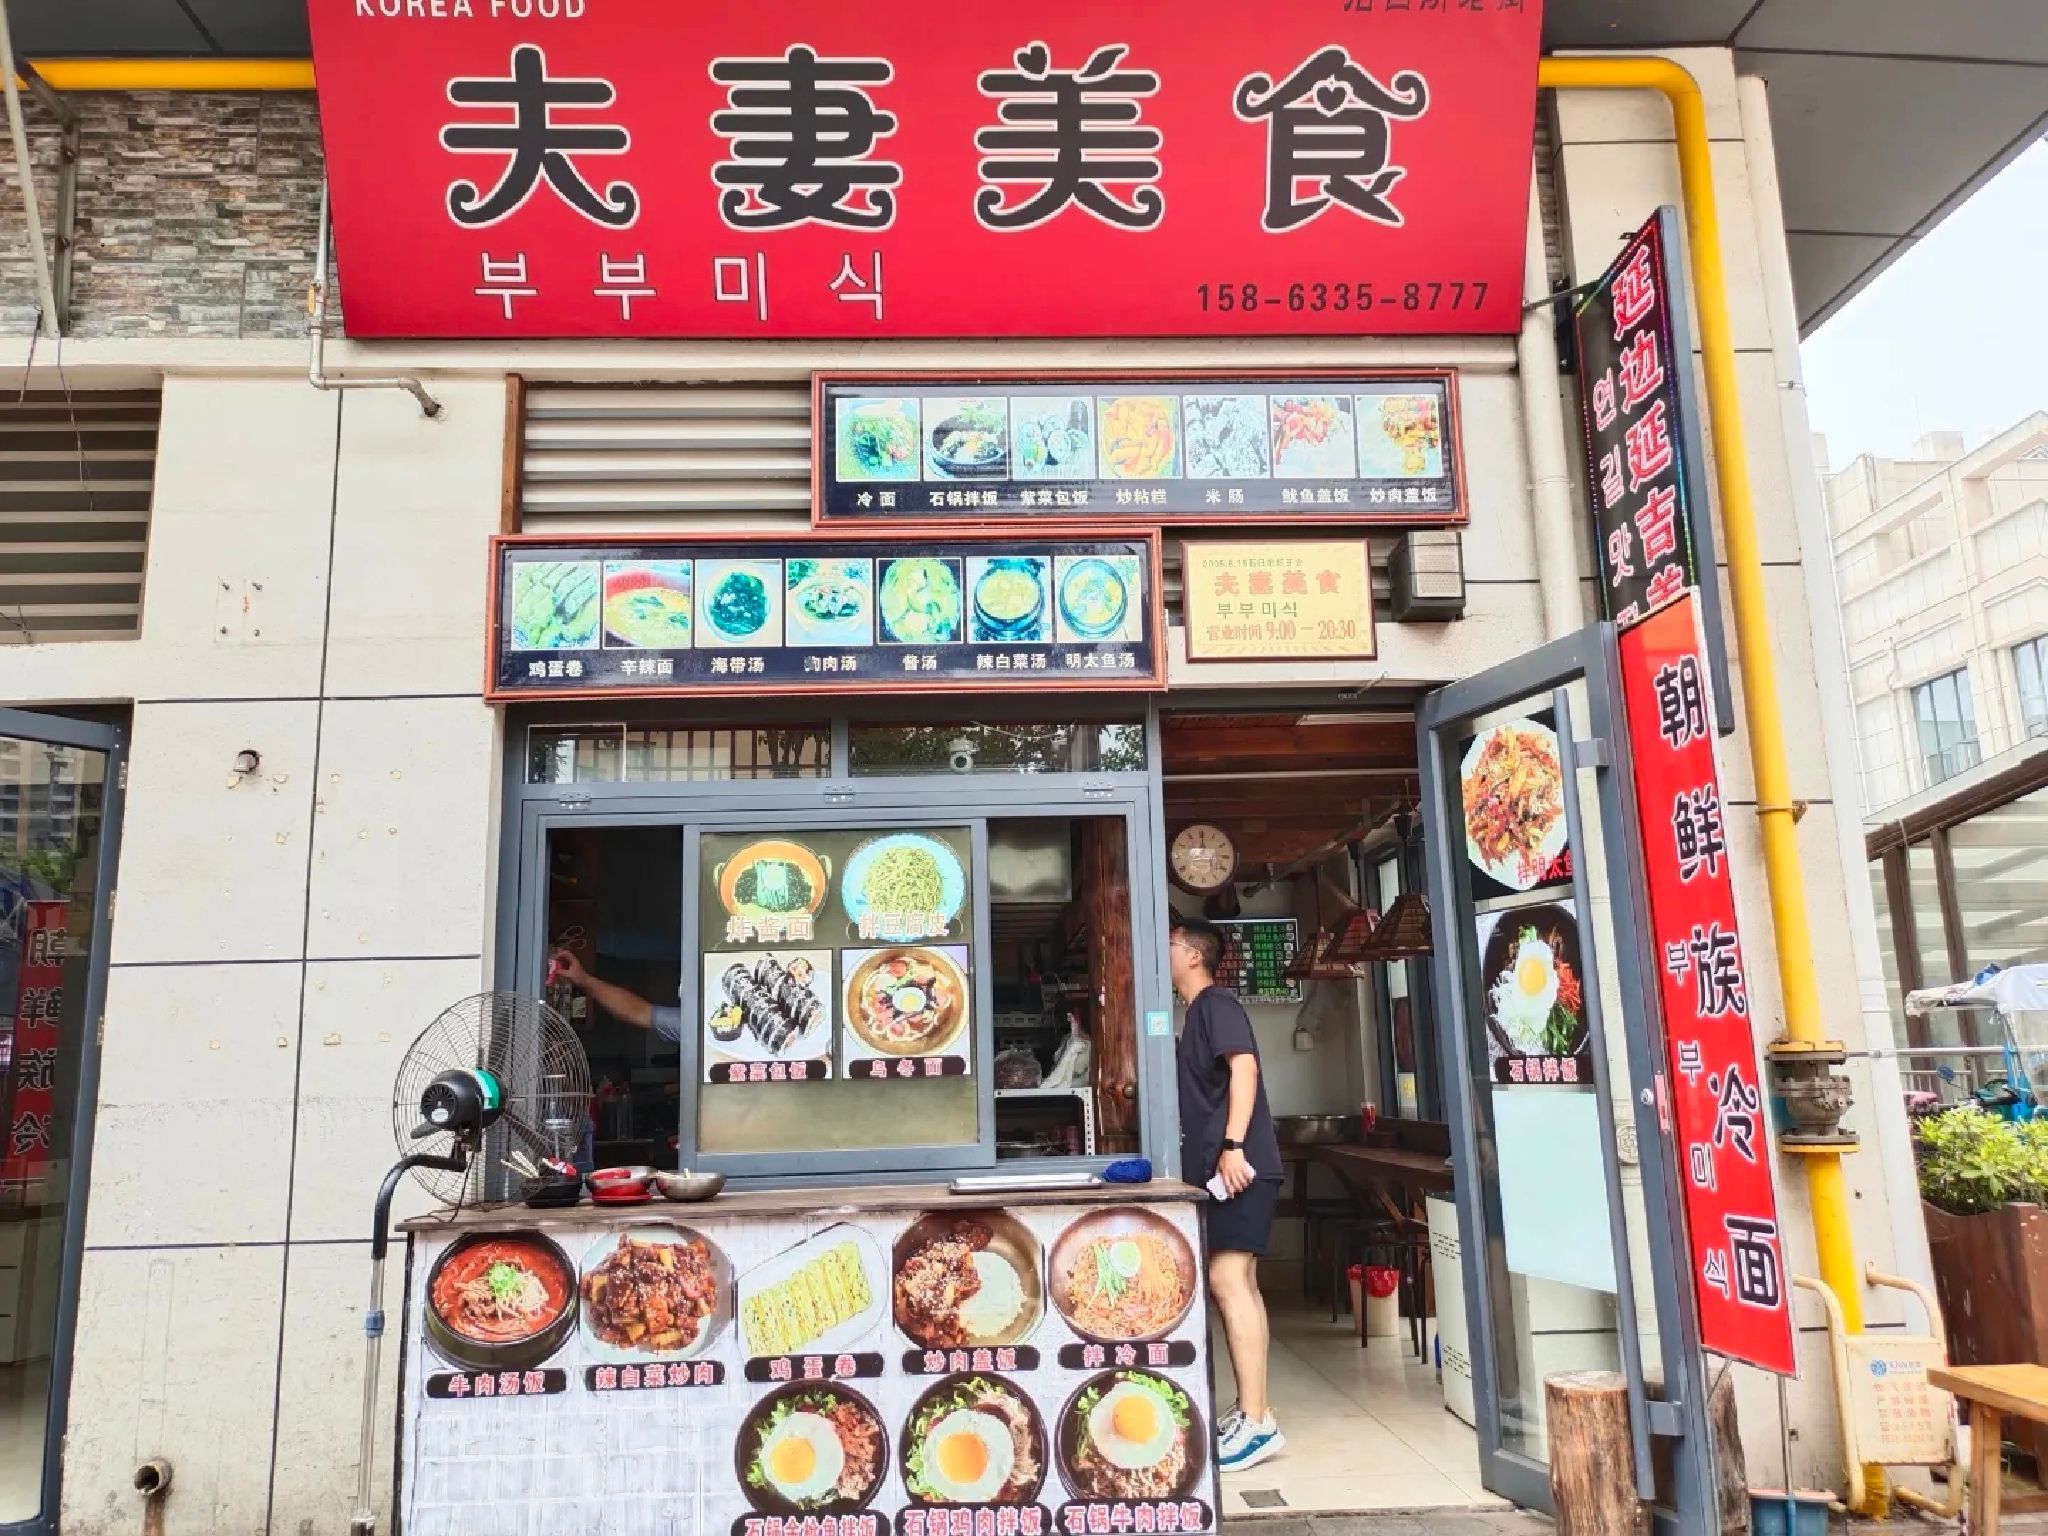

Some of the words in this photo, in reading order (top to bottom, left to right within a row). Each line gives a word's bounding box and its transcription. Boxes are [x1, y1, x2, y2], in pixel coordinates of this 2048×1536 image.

[439, 41, 1430, 233] 夫妻美食
[474, 251, 885, 322] 부부미식
[1197, 282, 1489, 313] 158-6335-8777
[856, 491, 896, 507] 冷面
[929, 491, 998, 507] 石锅拌饭
[1020, 489, 1089, 506] 紫菜包饭
[1214, 569, 1342, 596] 夫妻美食
[1216, 601, 1298, 619] 부부미식
[528, 660, 583, 678] 鸡蛋卷
[710, 656, 765, 674] 海带汤
[976, 653, 1046, 670] 辣白菜汤
[1065, 652, 1136, 669] 明太鱼汤
[726, 913, 814, 943] 炸酱面
[858, 909, 950, 938] 拌豆腐皮
[1654, 654, 1782, 1308] 朝鲜族冷面
[1508, 1057, 1578, 1082] 石锅拌饭
[1666, 938, 1729, 1299] 부부미식
[770, 1355, 857, 1379] 鸡蛋卷
[923, 1347, 1018, 1372] 炒肉盖饭
[1083, 1342, 1169, 1366] 拌冷面
[448, 1371, 545, 1398] 牛肉汤饭
[595, 1362, 715, 1390] 辣白菜炒肉
[903, 1506, 1043, 1536] 石锅鸡肉拌饭
[1064, 1501, 1203, 1533] 石锅牛肉拌饭
